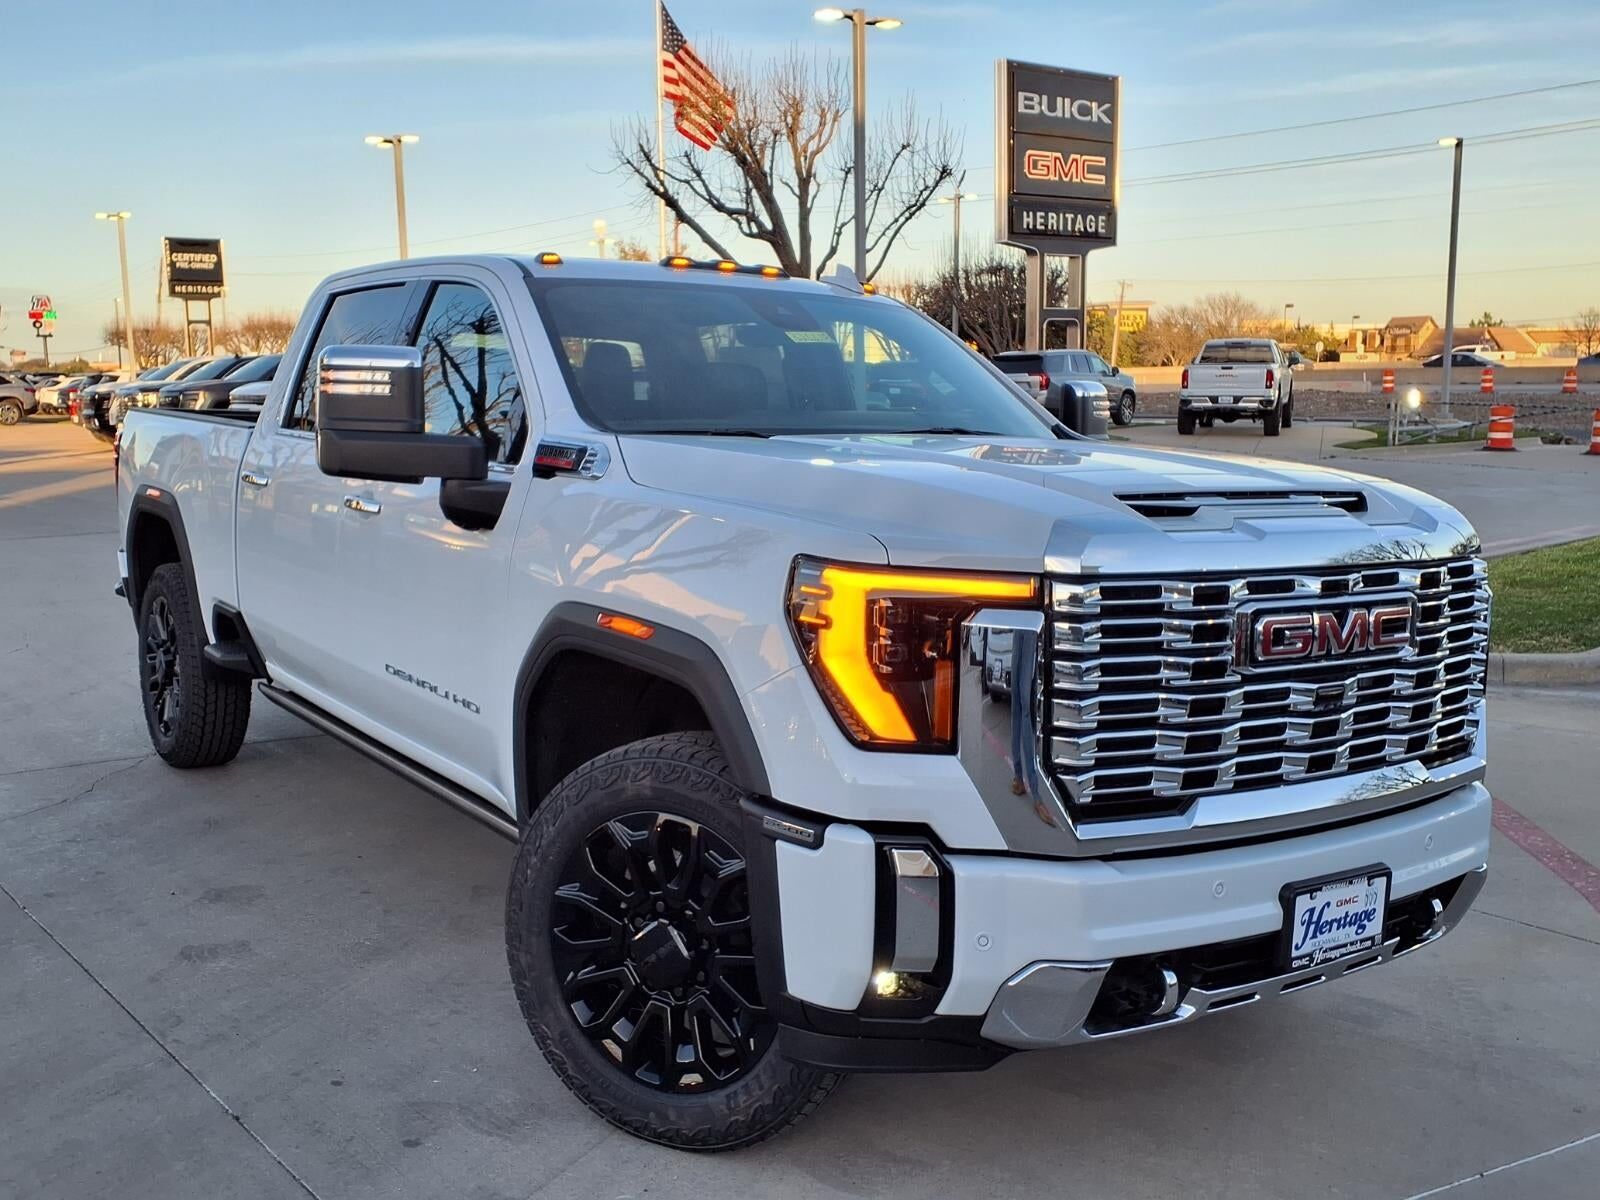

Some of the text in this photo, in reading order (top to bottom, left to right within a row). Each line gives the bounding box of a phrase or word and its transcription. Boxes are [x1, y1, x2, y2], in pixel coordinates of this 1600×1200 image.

[1018, 91, 1111, 124] BUICK
[1024, 149, 1106, 185] GMC
[1023, 210, 1106, 233] HERITAGE
[171, 252, 218, 262] CERTIFIED
[174, 284, 221, 294] HERITAGE
[1254, 606, 1412, 661] GMC
[385, 663, 481, 715] DENALI HD
[1335, 895, 1359, 908] GMC
[1294, 901, 1377, 951] Heritage
[1292, 957, 1310, 968] GMC
